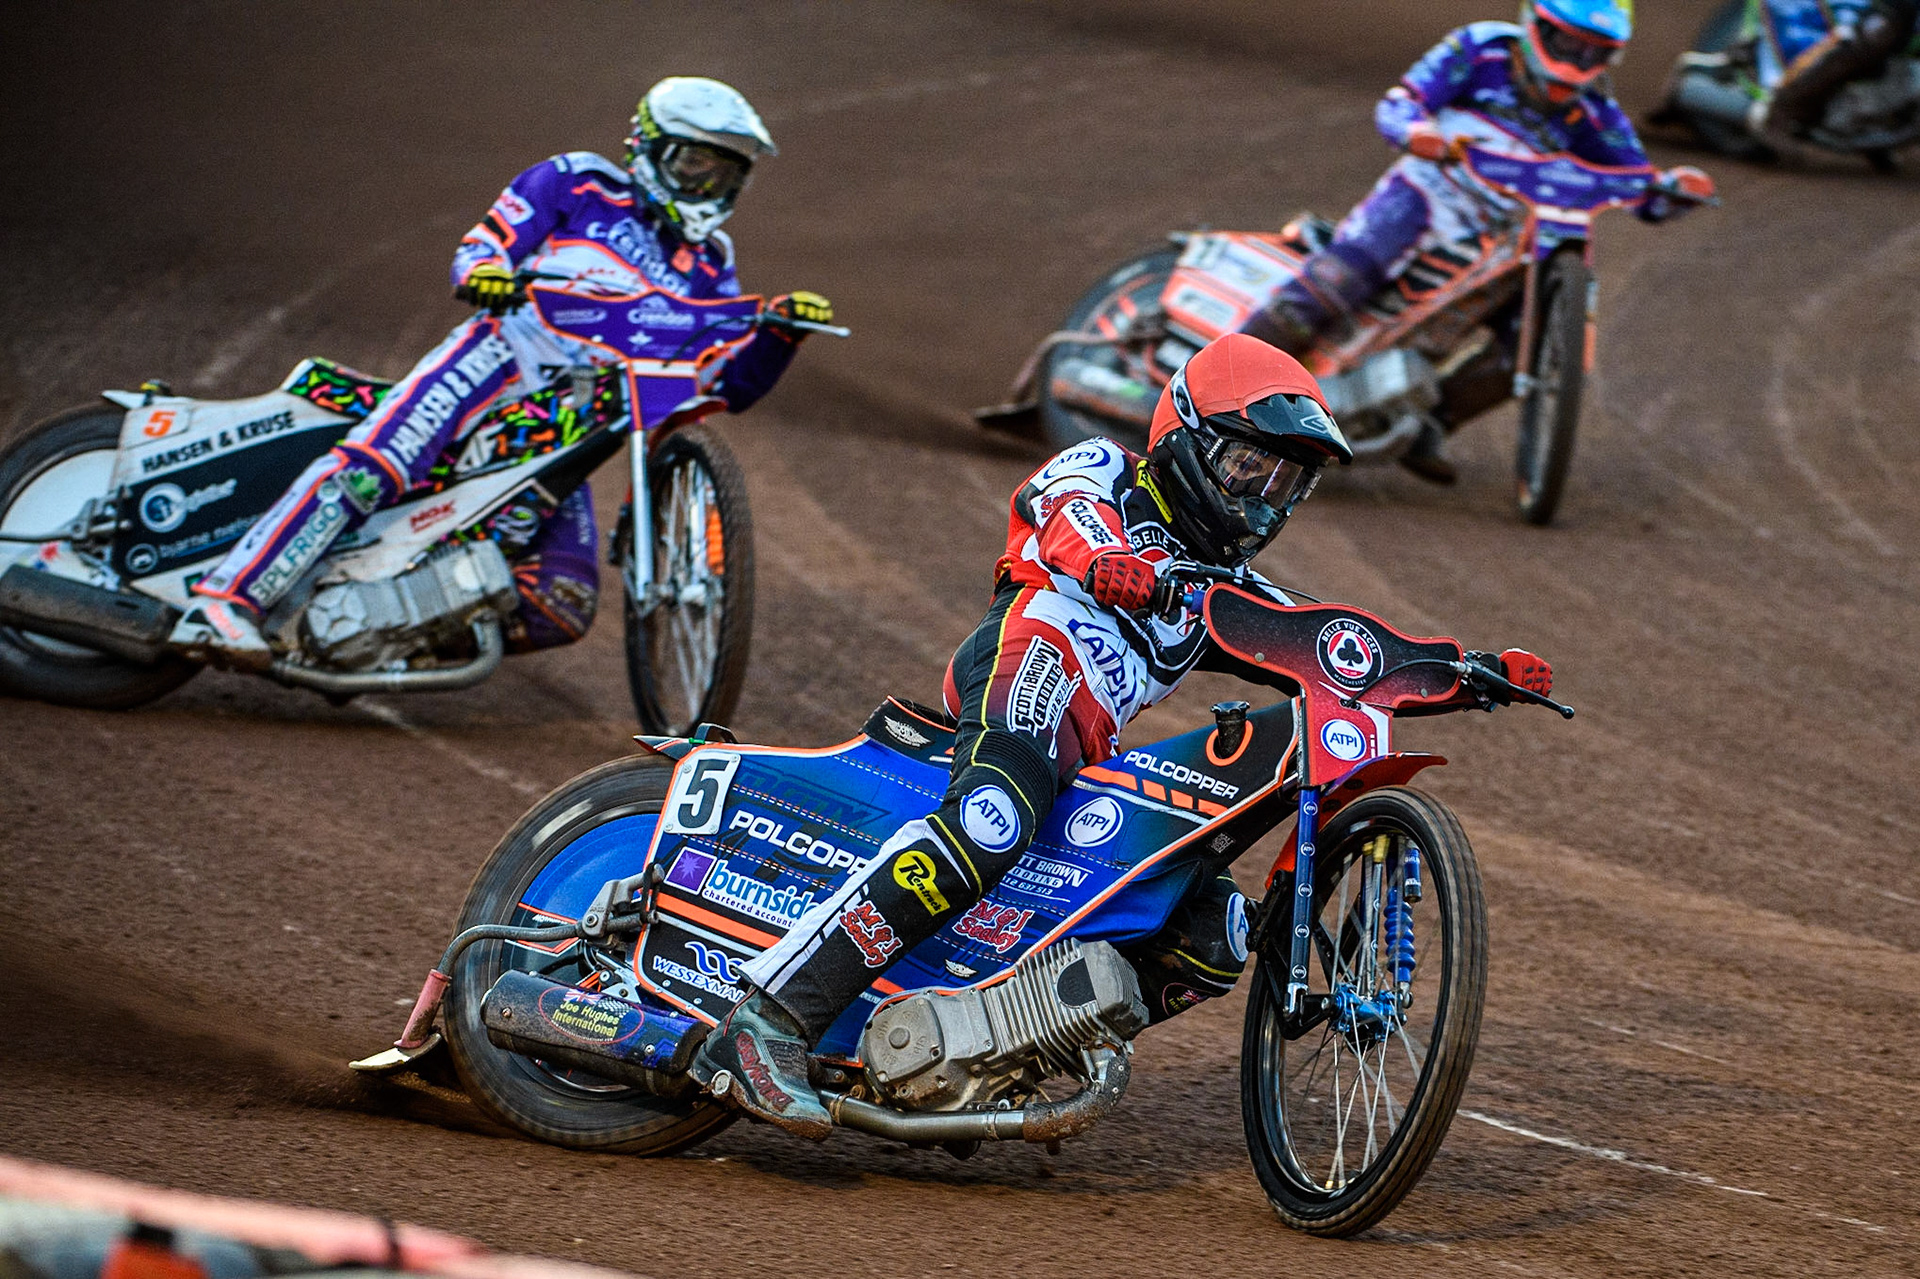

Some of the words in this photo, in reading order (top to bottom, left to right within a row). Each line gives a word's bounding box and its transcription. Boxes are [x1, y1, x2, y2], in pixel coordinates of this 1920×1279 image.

[142, 410, 177, 438] 5
[142, 436, 214, 473] HANSEN
[218, 430, 234, 449] &
[236, 410, 295, 442] KRUSE
[1132, 529, 1169, 549] BELLE
[1321, 622, 1341, 643] BELLE
[1343, 621, 1361, 634] VUE
[1361, 632, 1379, 654] ACES
[1034, 663, 1063, 726] FLOORING
[1329, 732, 1358, 748] ATPI
[1123, 750, 1240, 800] POLCOPPER
[677, 757, 728, 830] 5
[970, 797, 1012, 838] ATPI
[1074, 810, 1111, 832] ATPI
[1035, 859, 1089, 888] BROWN
[704, 888, 754, 914] chartered
[968, 899, 1004, 922] M
[1009, 909, 1034, 933] J
[839, 910, 888, 966] Sealey
[853, 902, 884, 928] M
[881, 938, 901, 954] J
[954, 916, 1020, 952] Sealey
[551, 1009, 618, 1038] International
[560, 1000, 580, 1013] Joe
[580, 1005, 620, 1026] Hughes
